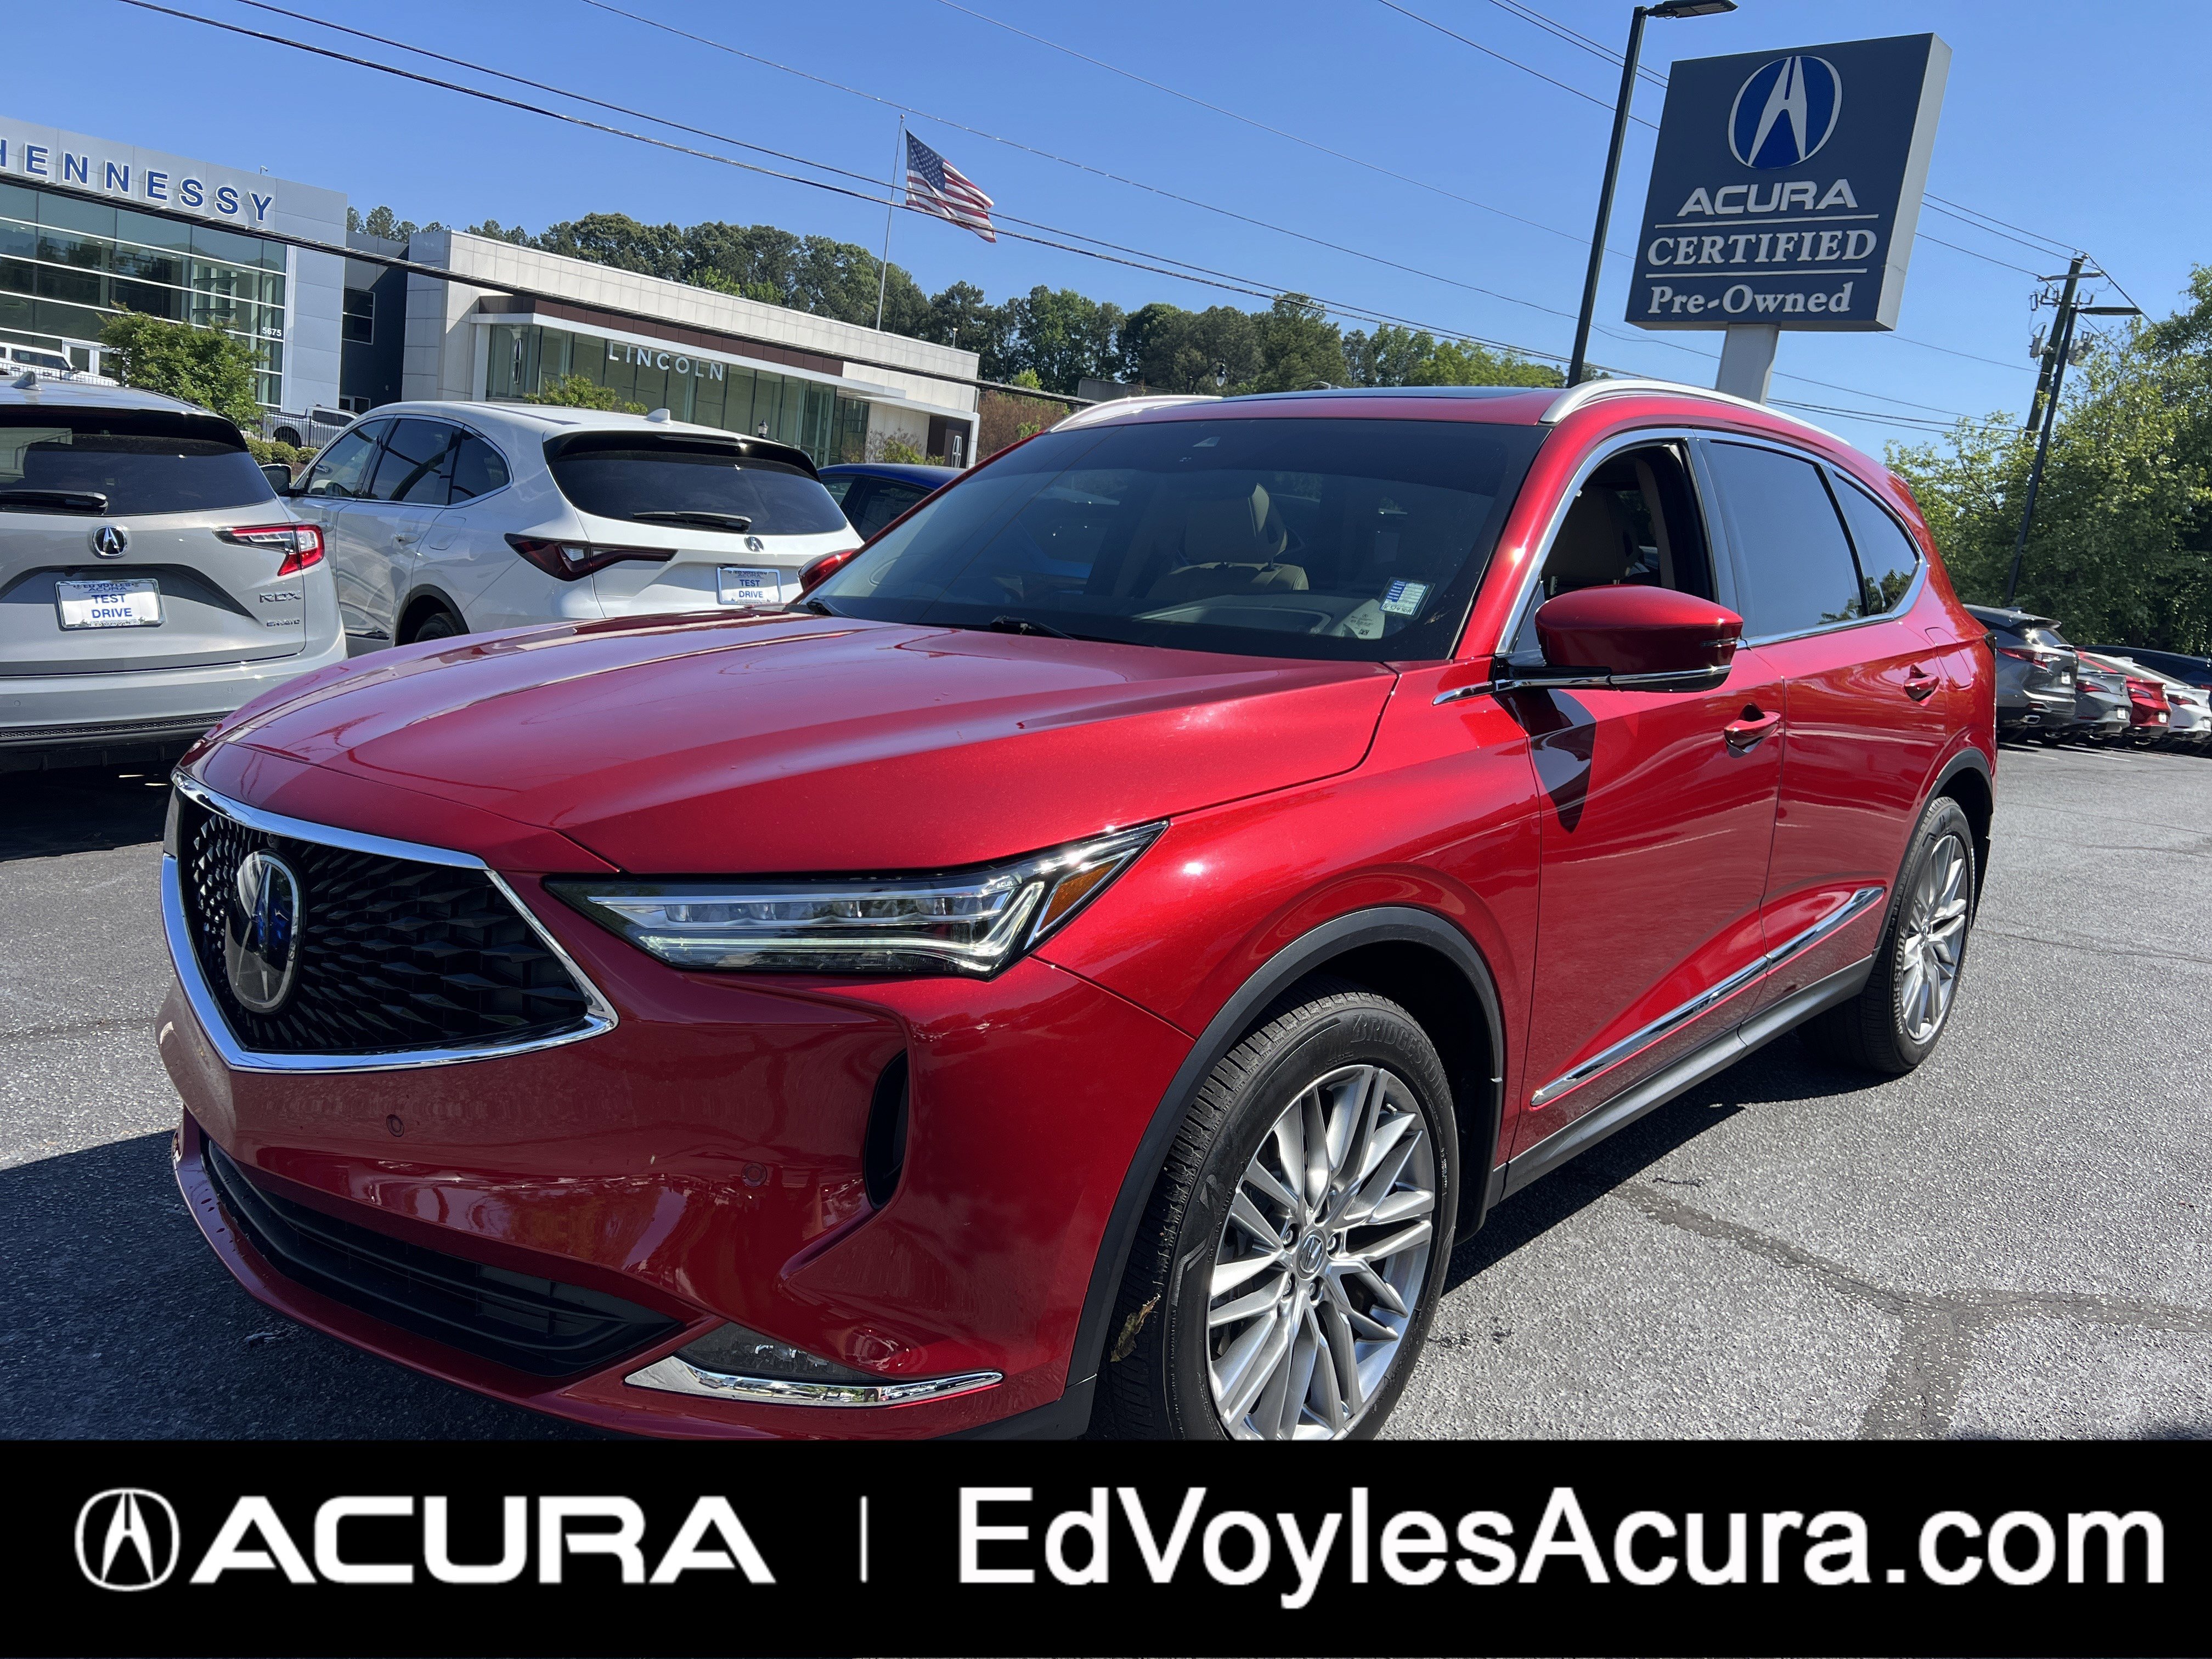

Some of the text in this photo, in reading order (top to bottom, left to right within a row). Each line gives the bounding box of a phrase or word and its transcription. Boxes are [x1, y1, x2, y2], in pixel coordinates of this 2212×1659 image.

[1677, 178, 1858, 217] ACURA
[1647, 229, 1877, 266] CERTIFIED
[1647, 281, 1853, 314] Pre-Owned
[262, 326, 282, 337] 5675
[608, 342, 723, 381] LINCOLN
[91, 594, 126, 604] TEST
[91, 608, 132, 618] DRIVE
